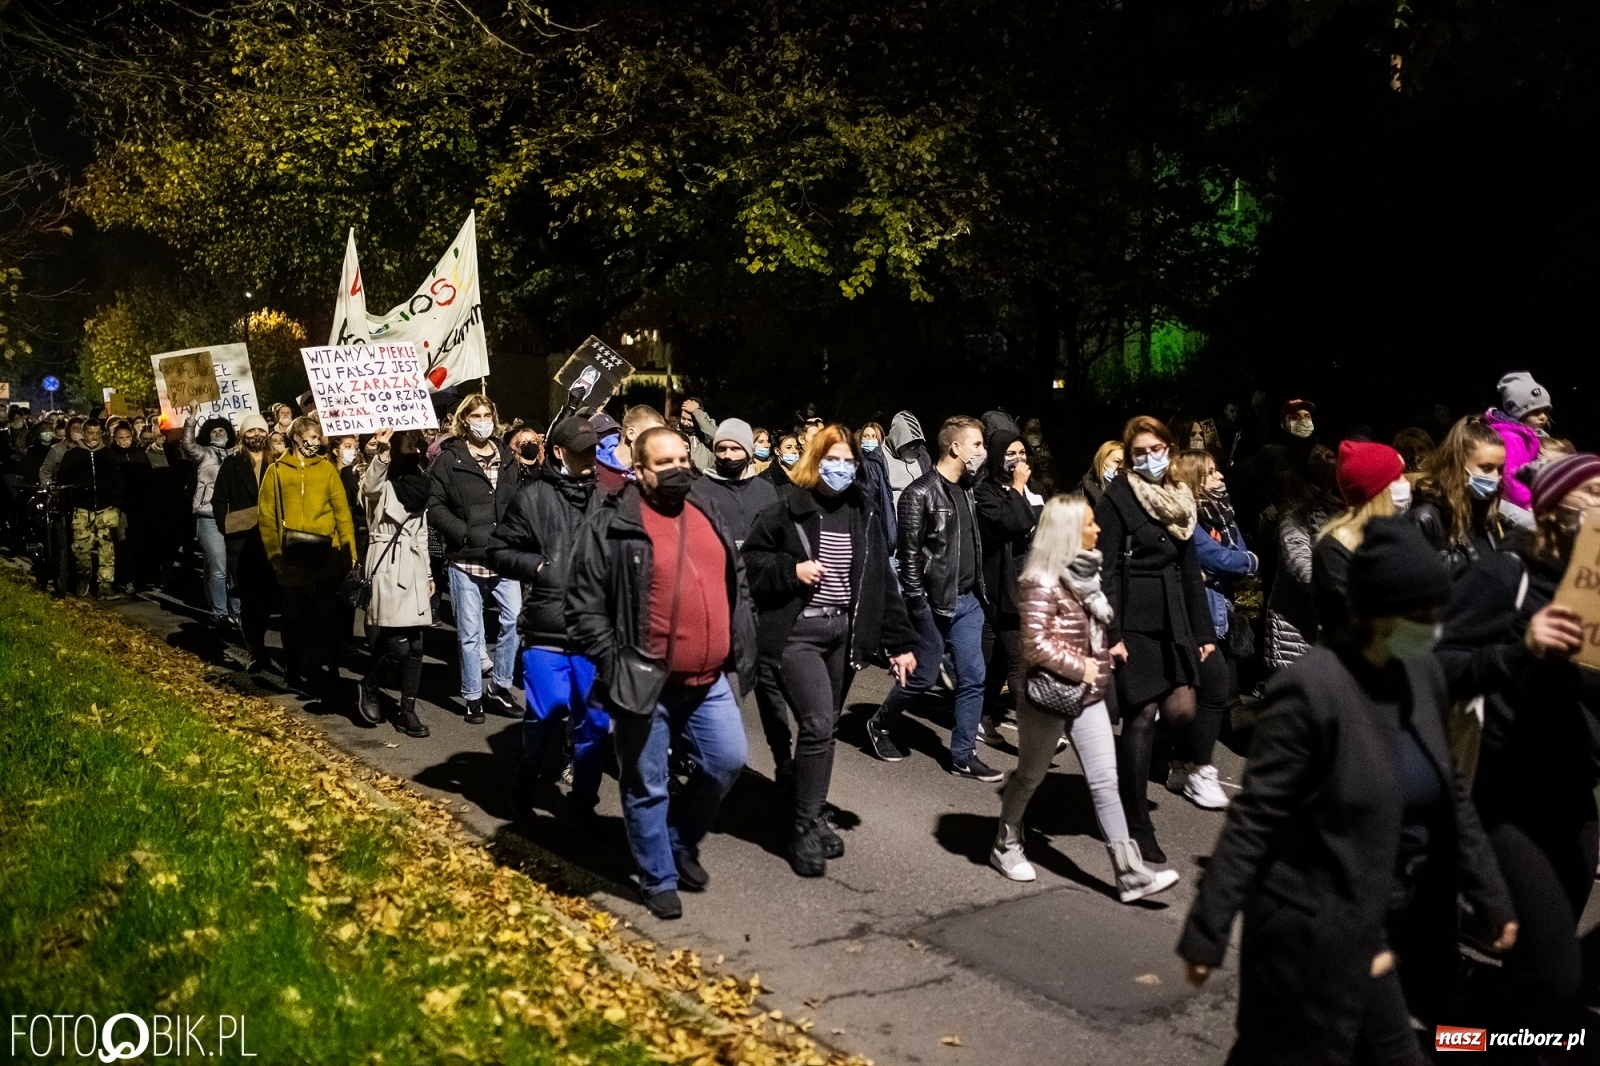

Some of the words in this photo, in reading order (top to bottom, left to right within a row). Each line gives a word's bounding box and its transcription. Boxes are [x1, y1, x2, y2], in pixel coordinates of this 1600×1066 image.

[306, 347, 361, 364] WITAMY
[366, 347, 376, 360] W
[379, 346, 416, 360] PIEKLE
[310, 367, 331, 381] TU
[336, 361, 387, 379] FAŁSZ
[392, 360, 419, 374] JEST
[317, 382, 347, 395] JAK
[211, 393, 252, 413] BABĘ
[361, 392, 377, 404] TO
[378, 391, 392, 401] CO
[376, 404, 389, 413] CO
[326, 419, 364, 433] MEDIA
[369, 418, 374, 428] I
